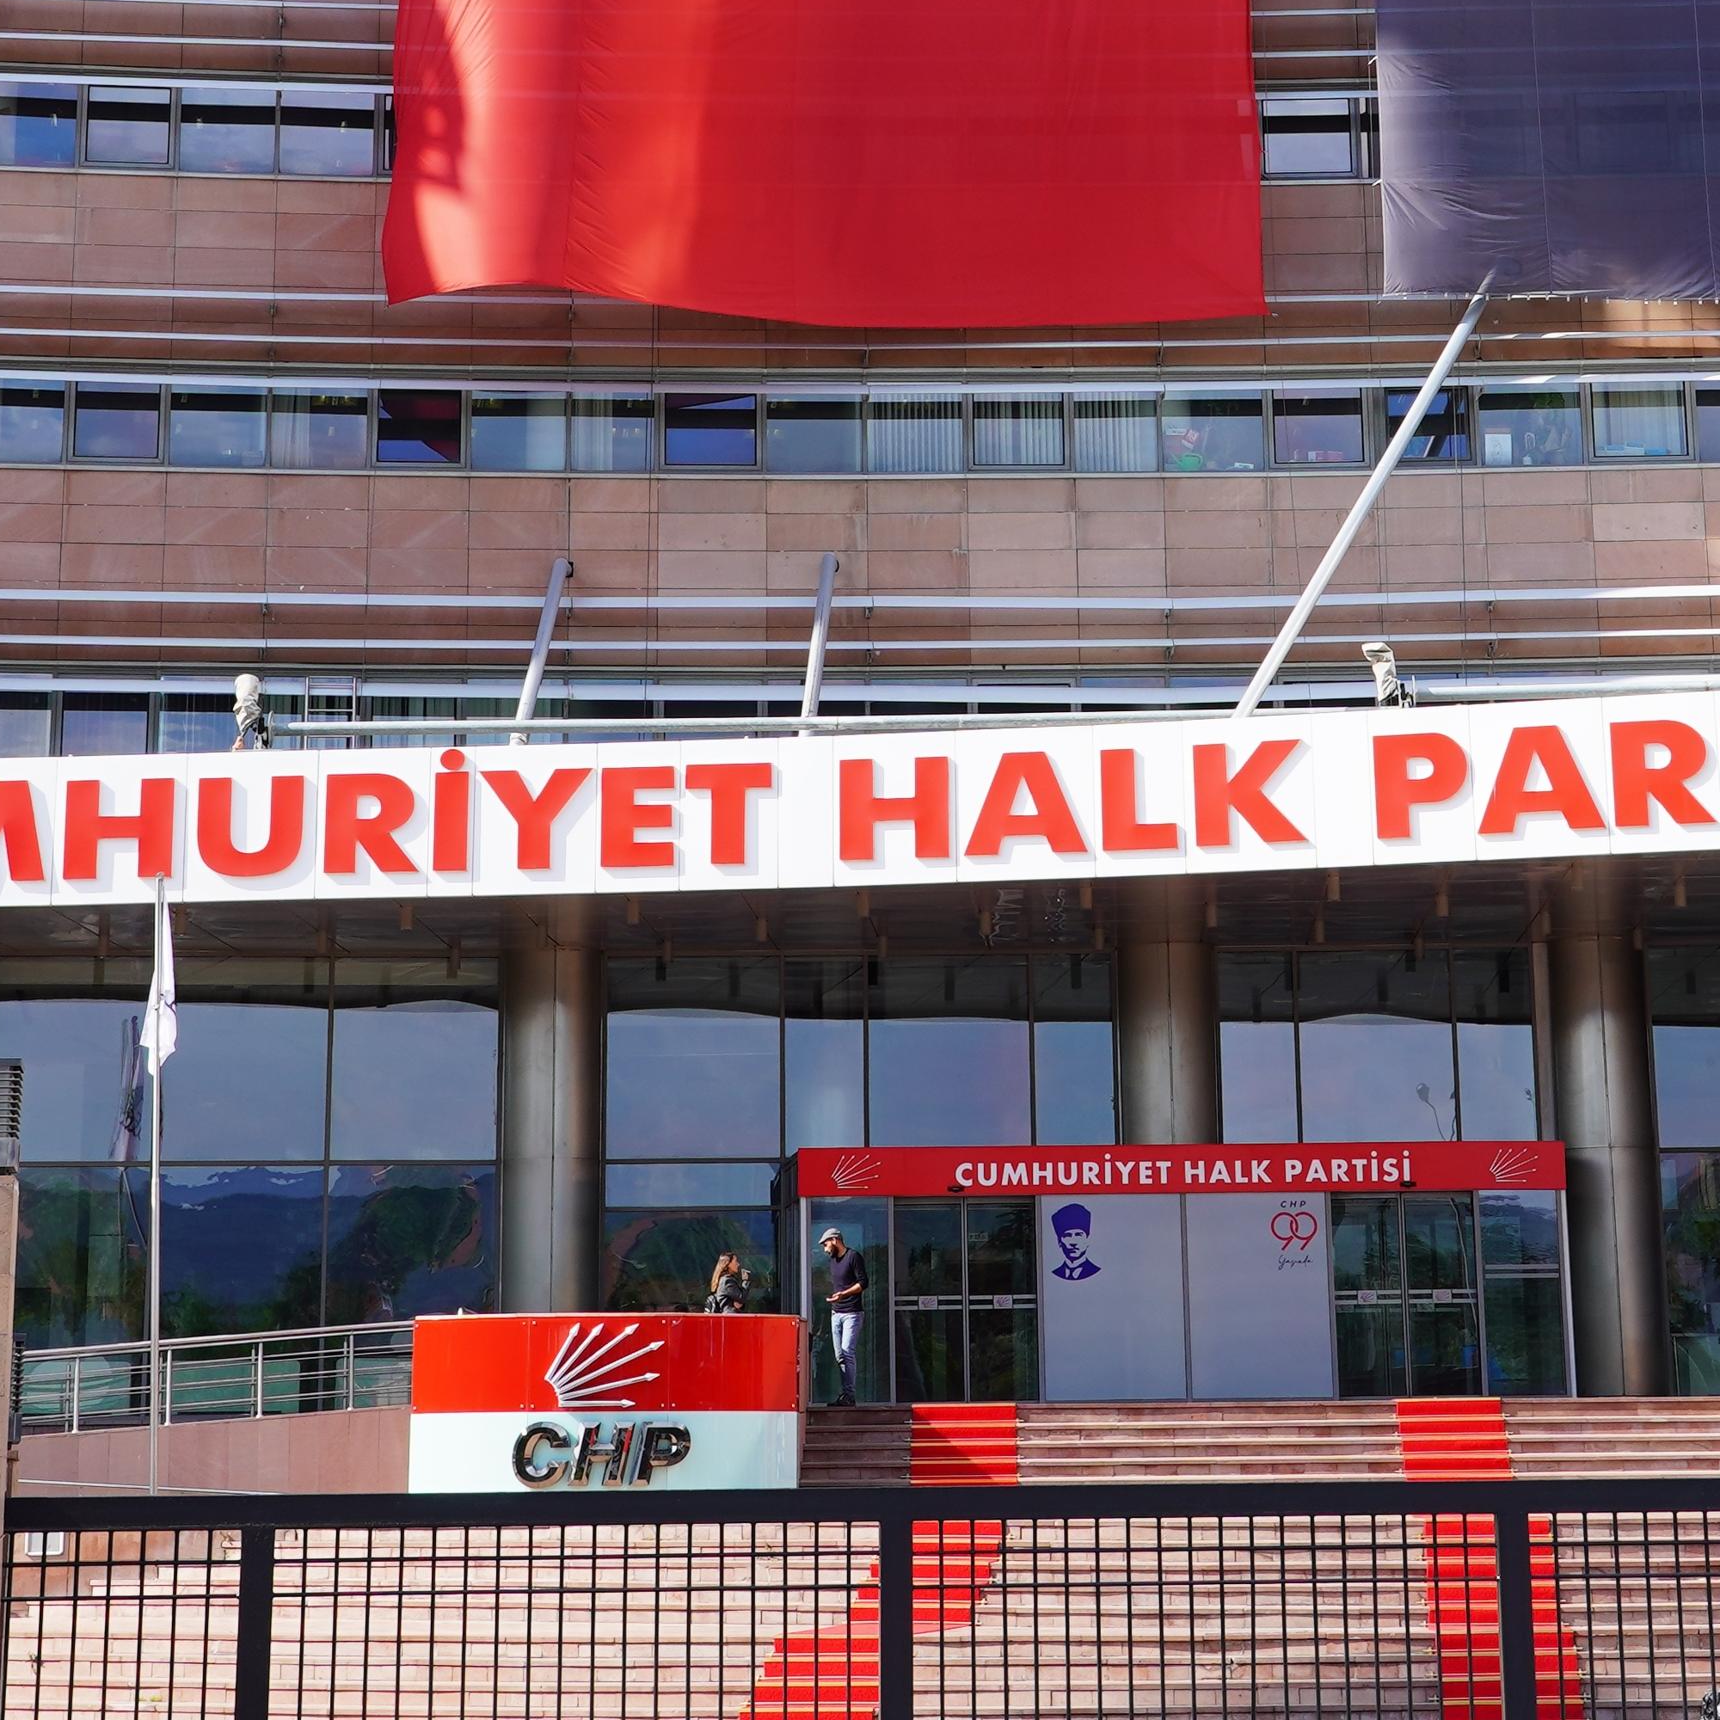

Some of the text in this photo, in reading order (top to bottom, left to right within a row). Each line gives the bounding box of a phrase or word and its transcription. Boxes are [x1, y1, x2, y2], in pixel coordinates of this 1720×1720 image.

[840, 740, 1304, 860] HALK
[955, 1150, 1411, 1187] CUMHURİYET HALK PARTİSİ
[1280, 1200, 1307, 1209] CHP
[1270, 1211, 1318, 1252] 99
[512, 1420, 692, 1489] CHP
